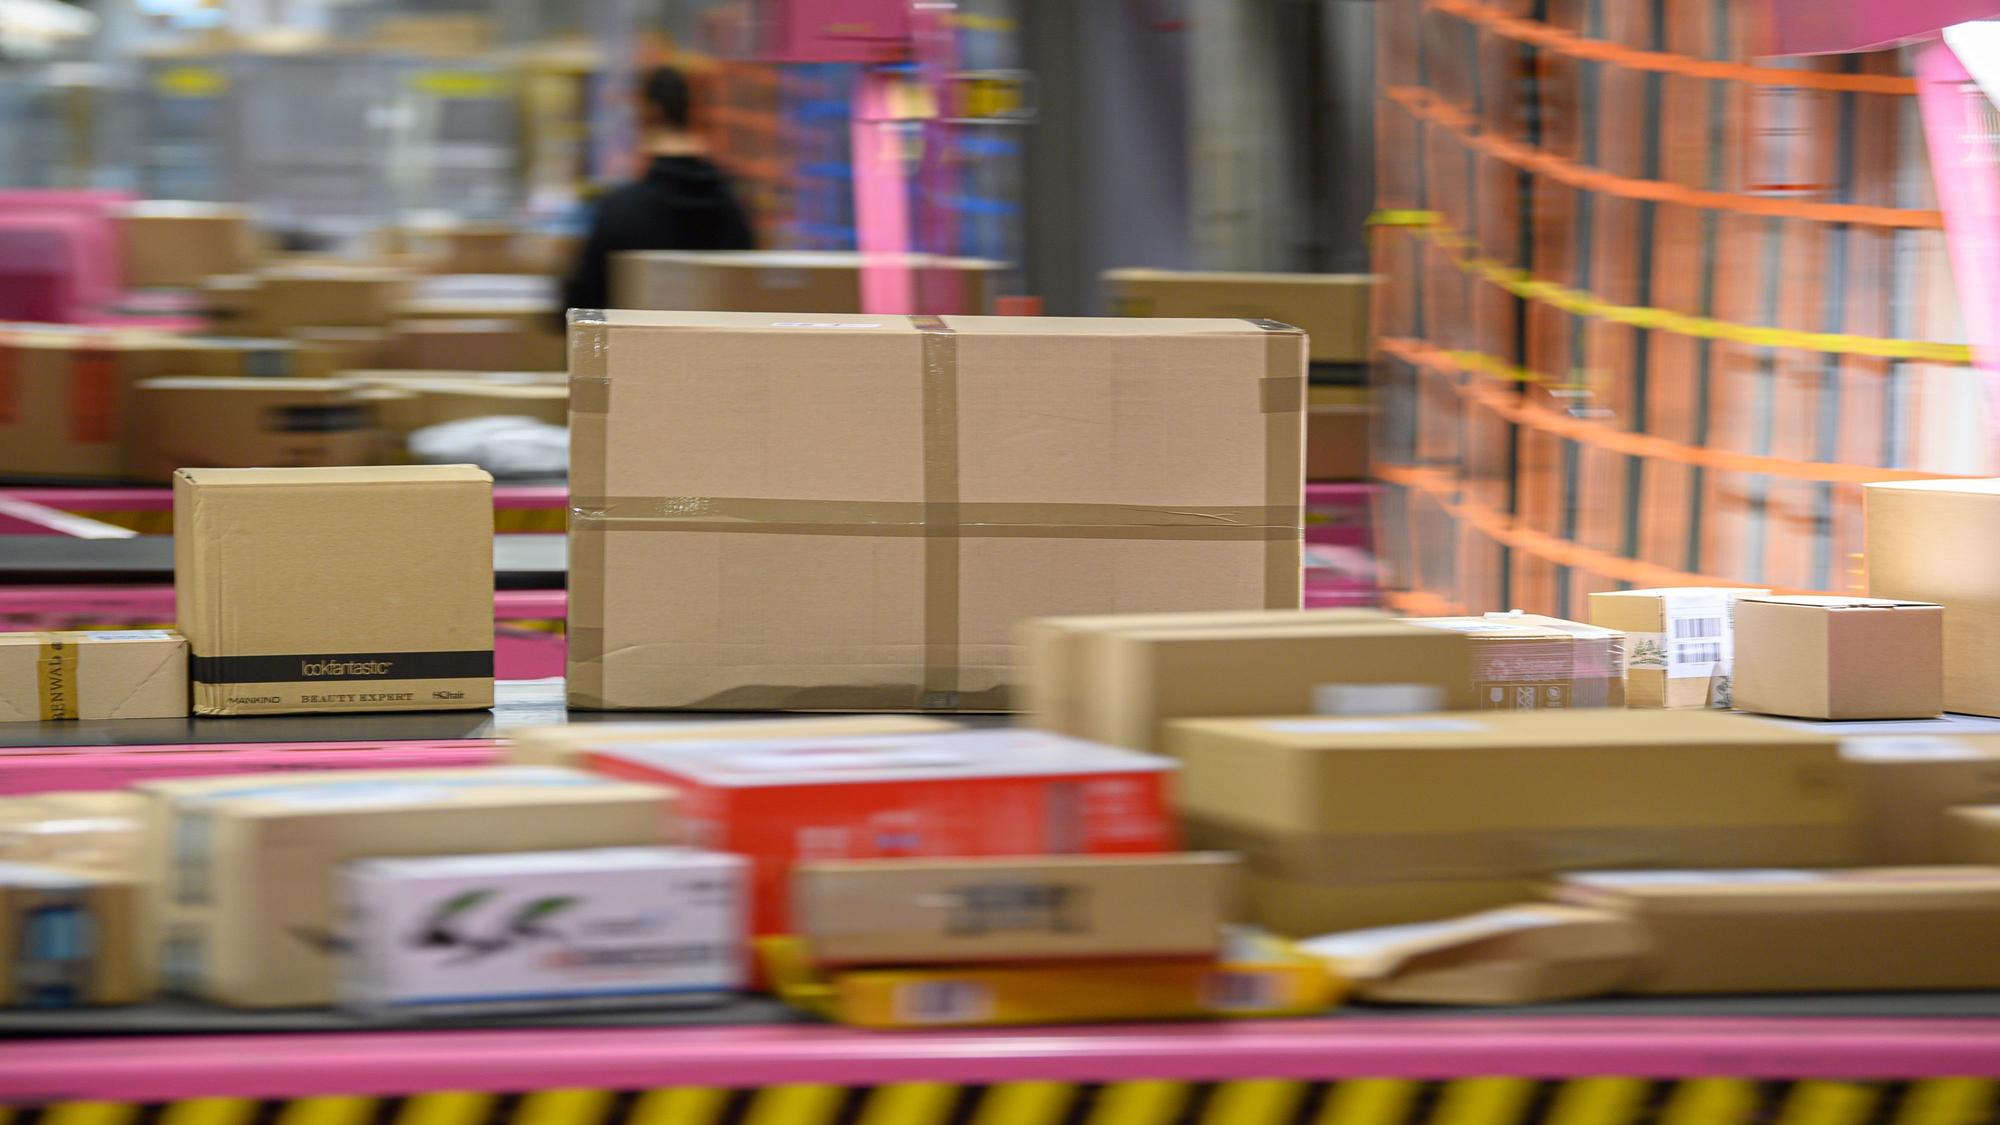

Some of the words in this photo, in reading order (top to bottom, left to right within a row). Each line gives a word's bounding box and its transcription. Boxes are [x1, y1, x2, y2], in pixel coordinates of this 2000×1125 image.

[301, 660, 390, 676] lookfantastic
[228, 696, 281, 704] MANKIND
[301, 694, 356, 704] BEAUTY
[359, 692, 414, 702] EXPERT
